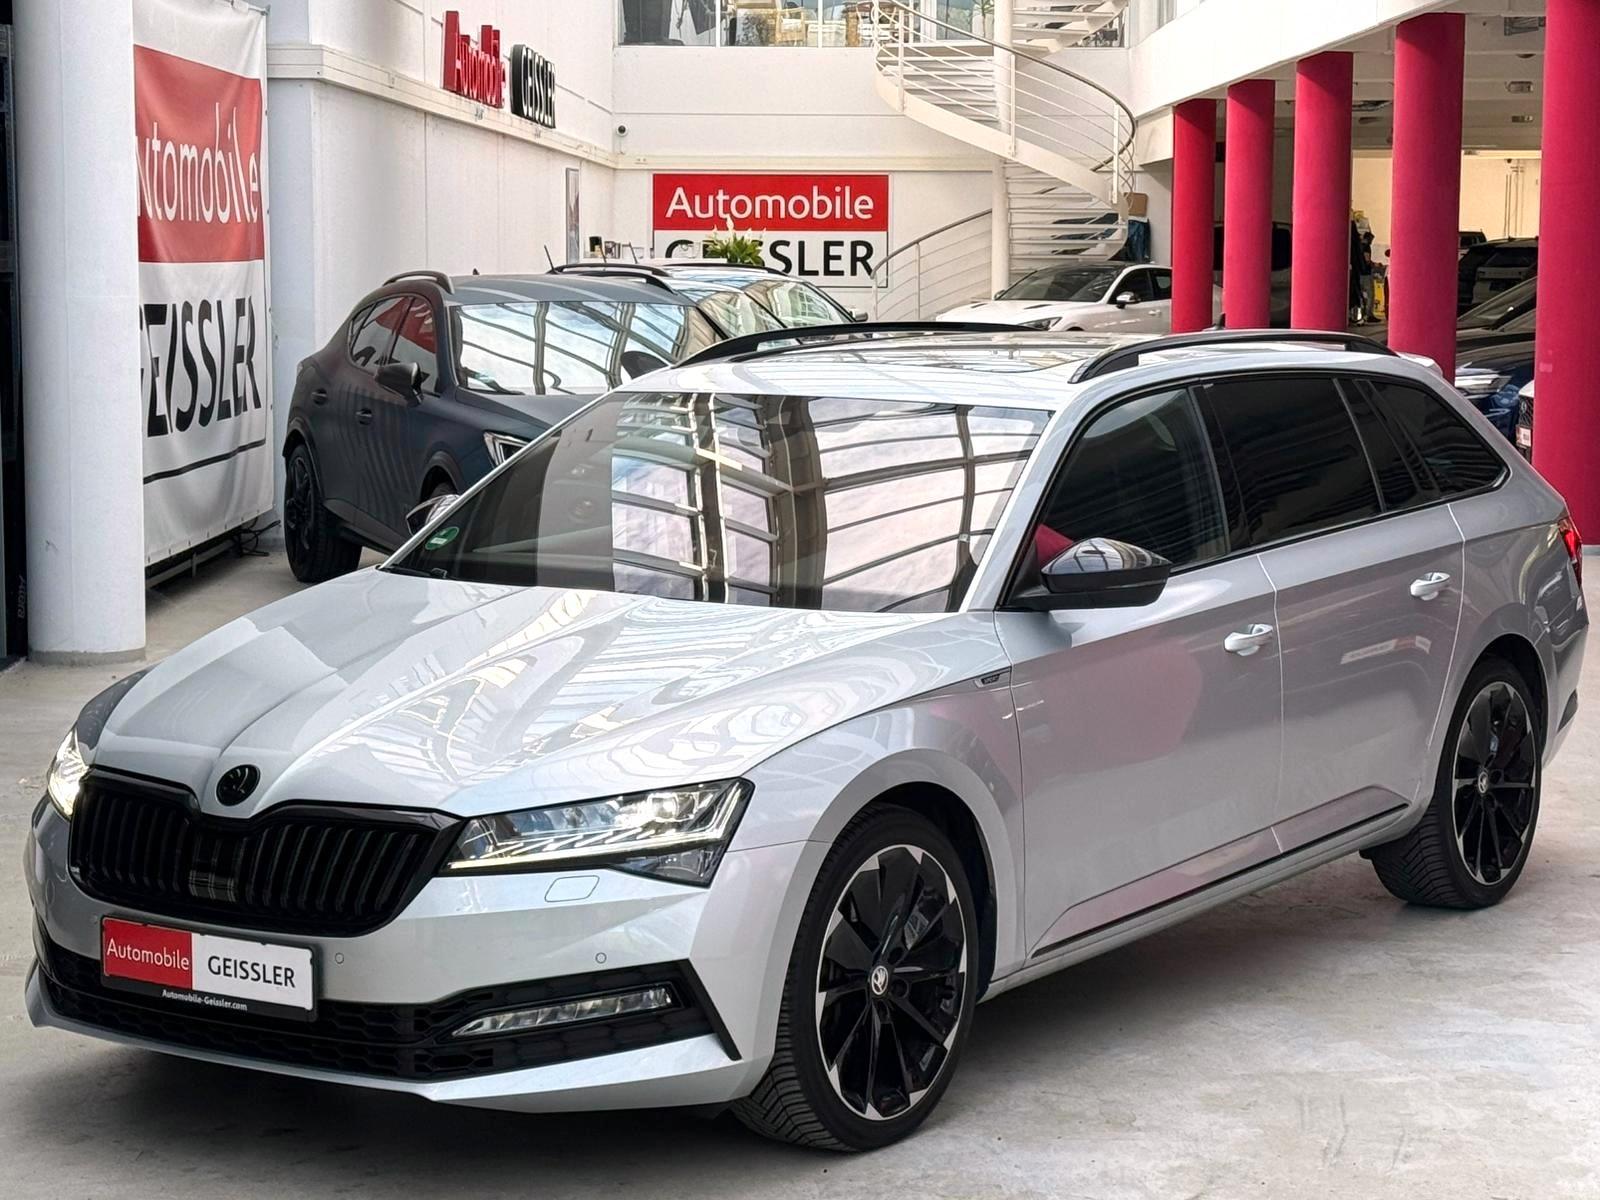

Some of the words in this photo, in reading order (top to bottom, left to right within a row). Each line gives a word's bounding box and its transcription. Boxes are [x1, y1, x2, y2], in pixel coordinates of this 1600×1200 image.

[135, 101, 259, 223] utomobile
[665, 185, 874, 219] Automobile
[139, 295, 262, 437] EISSLER
[106, 938, 190, 971] Automobile
[207, 955, 296, 988] GEISSLER
[161, 988, 248, 1011] Automobile-Geissler.com
